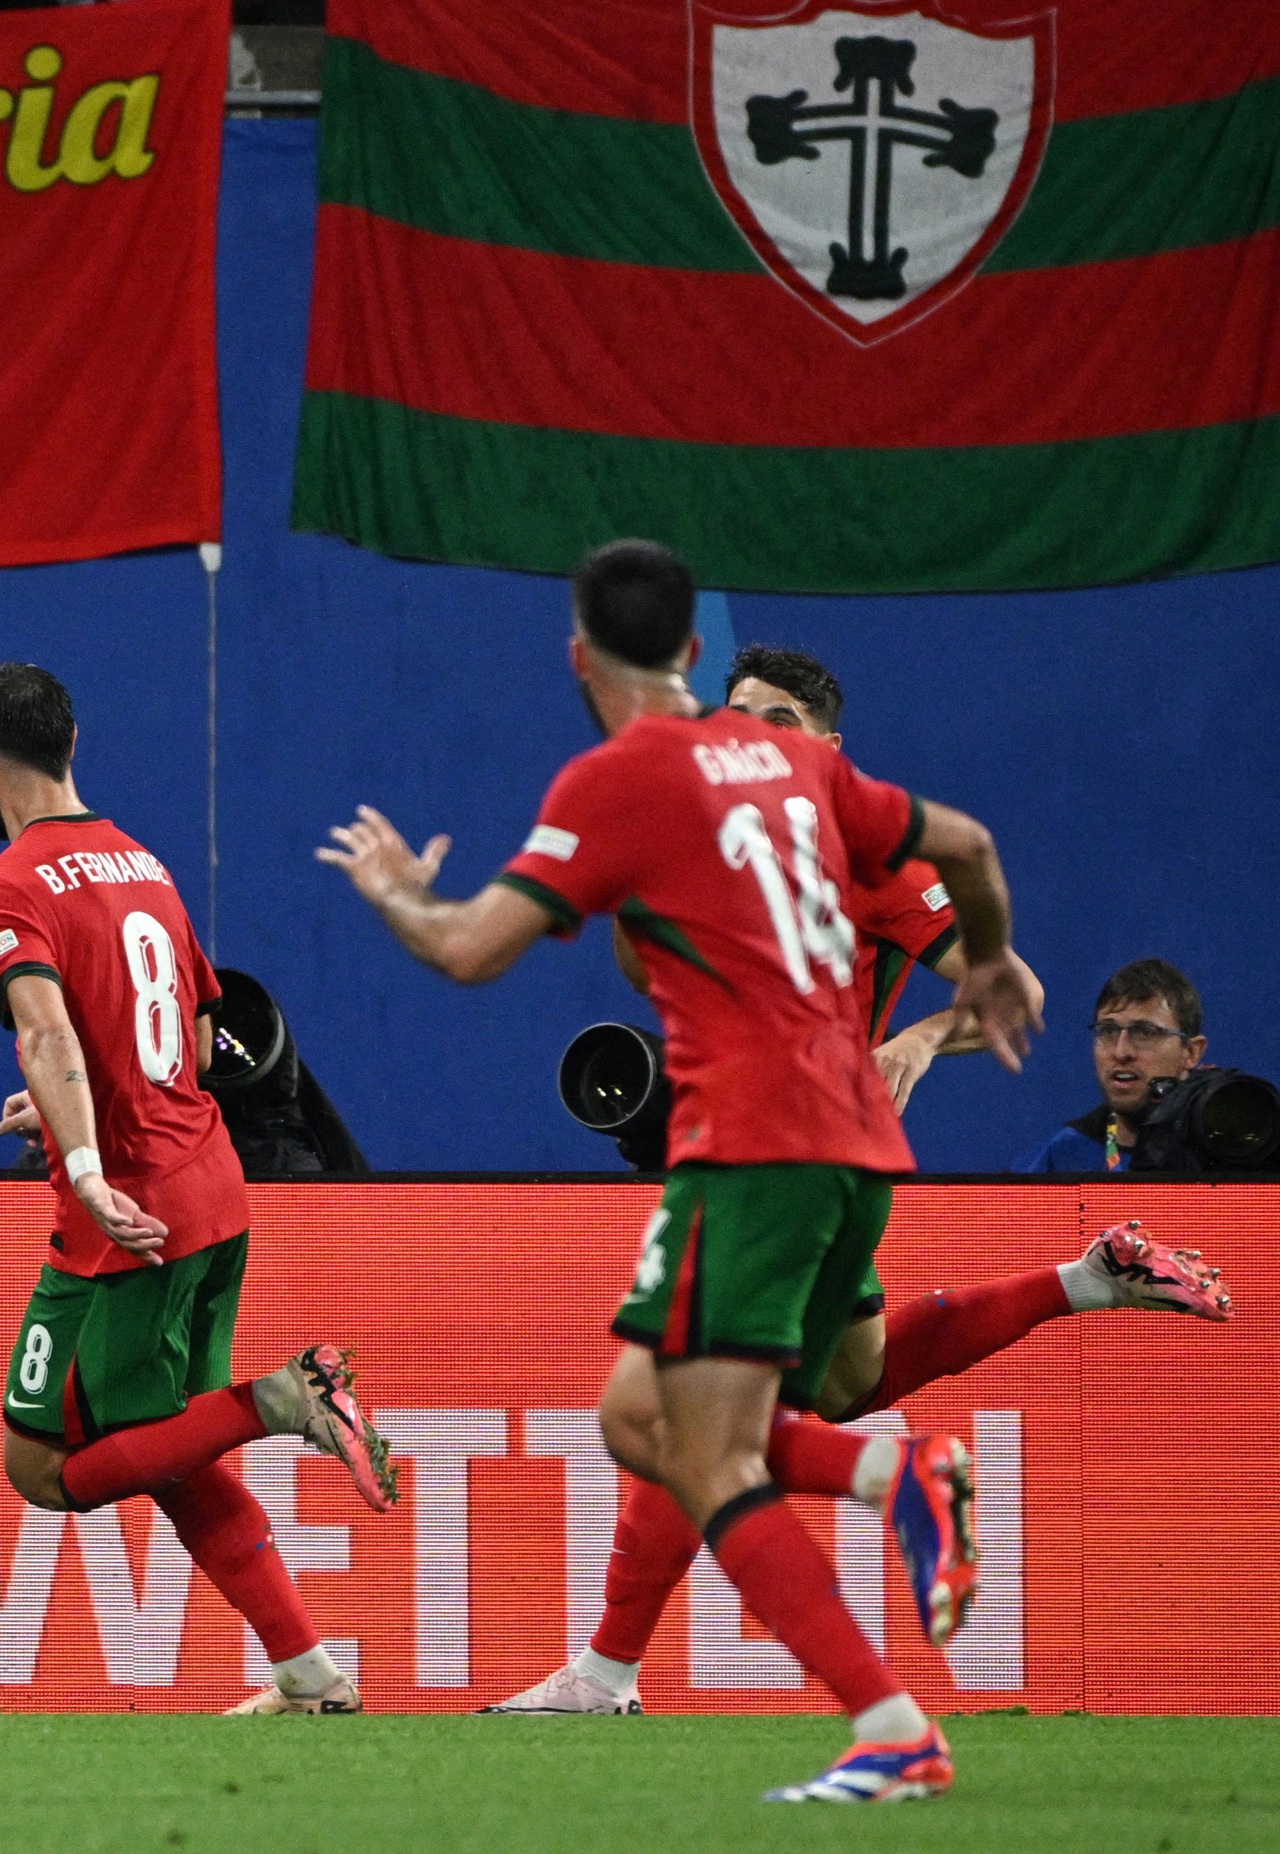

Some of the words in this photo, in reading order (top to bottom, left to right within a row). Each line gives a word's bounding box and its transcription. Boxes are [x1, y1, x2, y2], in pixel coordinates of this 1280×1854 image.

[34, 850, 173, 895] B.FERNANDE
[718, 796, 859, 995] 14
[123, 911, 183, 1087] 8
[638, 1208, 672, 1294] 4
[20, 1324, 53, 1395] 8
